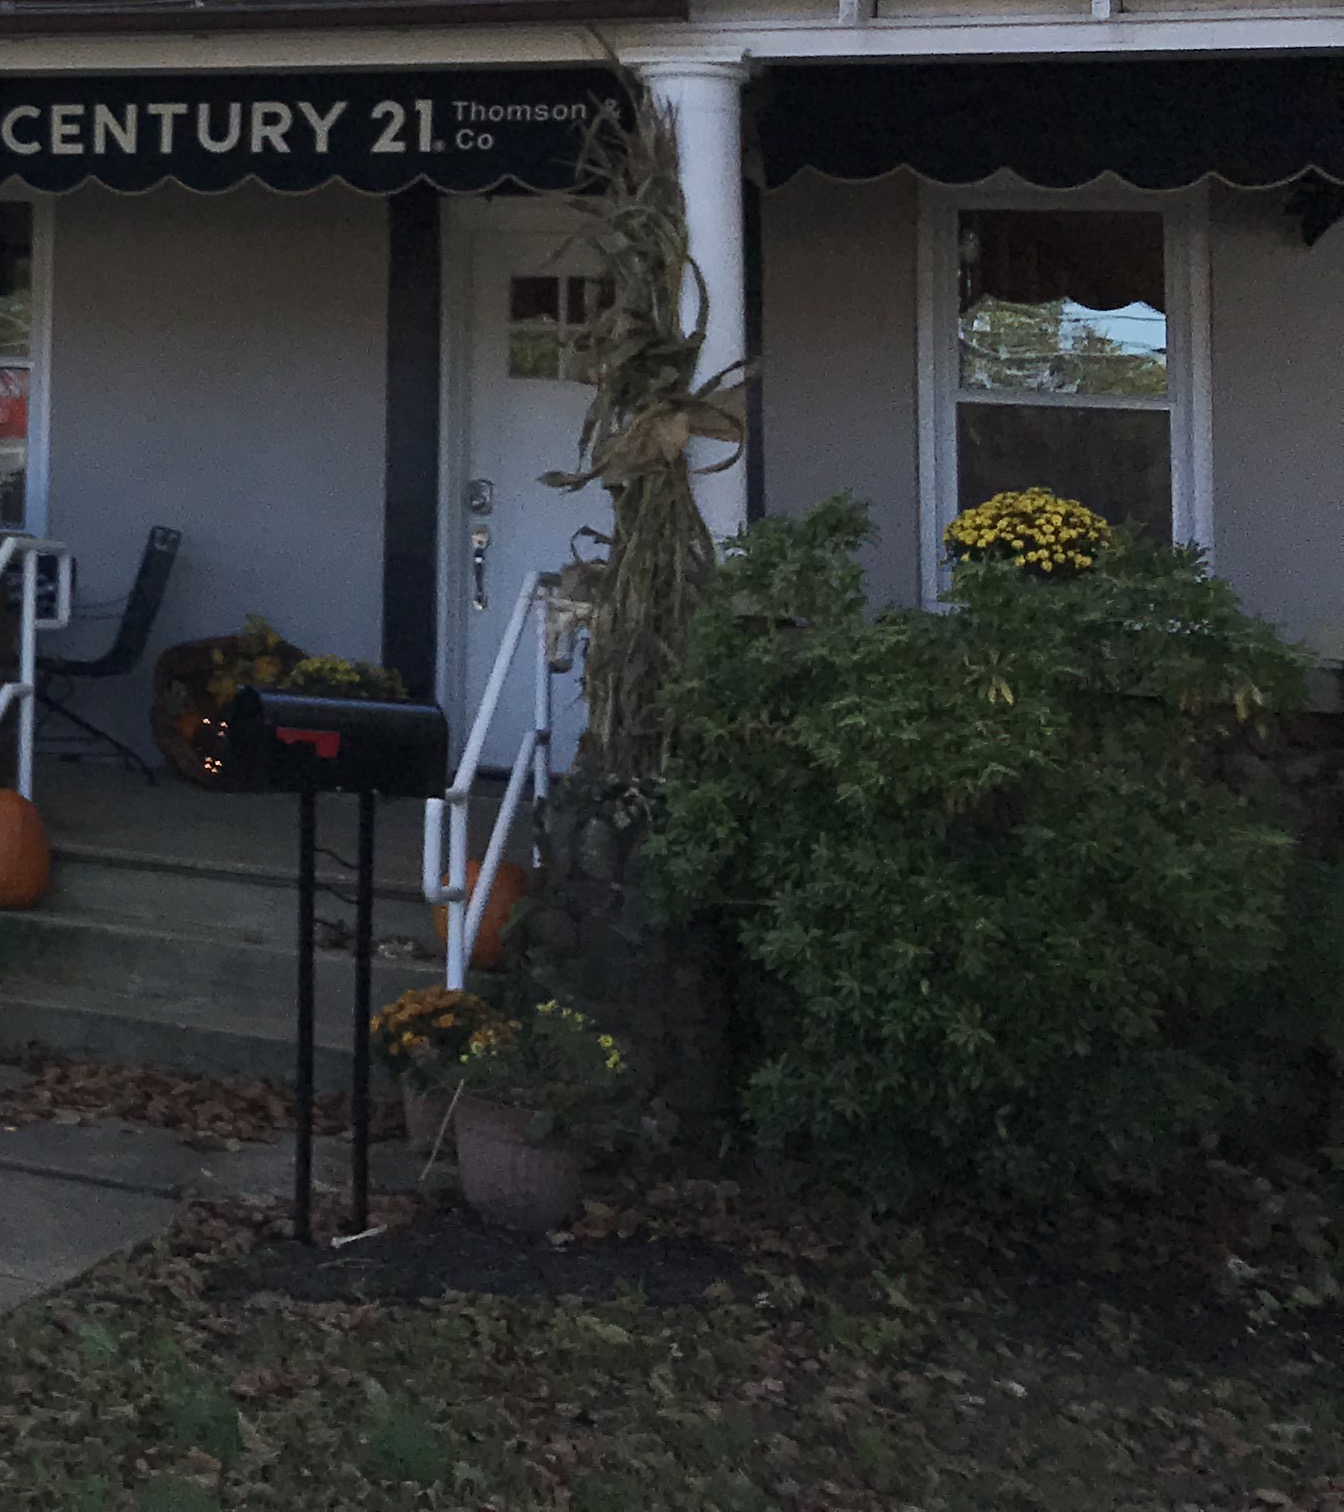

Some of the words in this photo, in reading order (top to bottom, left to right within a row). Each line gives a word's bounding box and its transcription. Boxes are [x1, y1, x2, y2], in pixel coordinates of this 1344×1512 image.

[0, 99, 346, 155] CENTURY
[370, 98, 433, 153] 21
[452, 100, 587, 122] Thomson
[455, 128, 494, 150] Co
